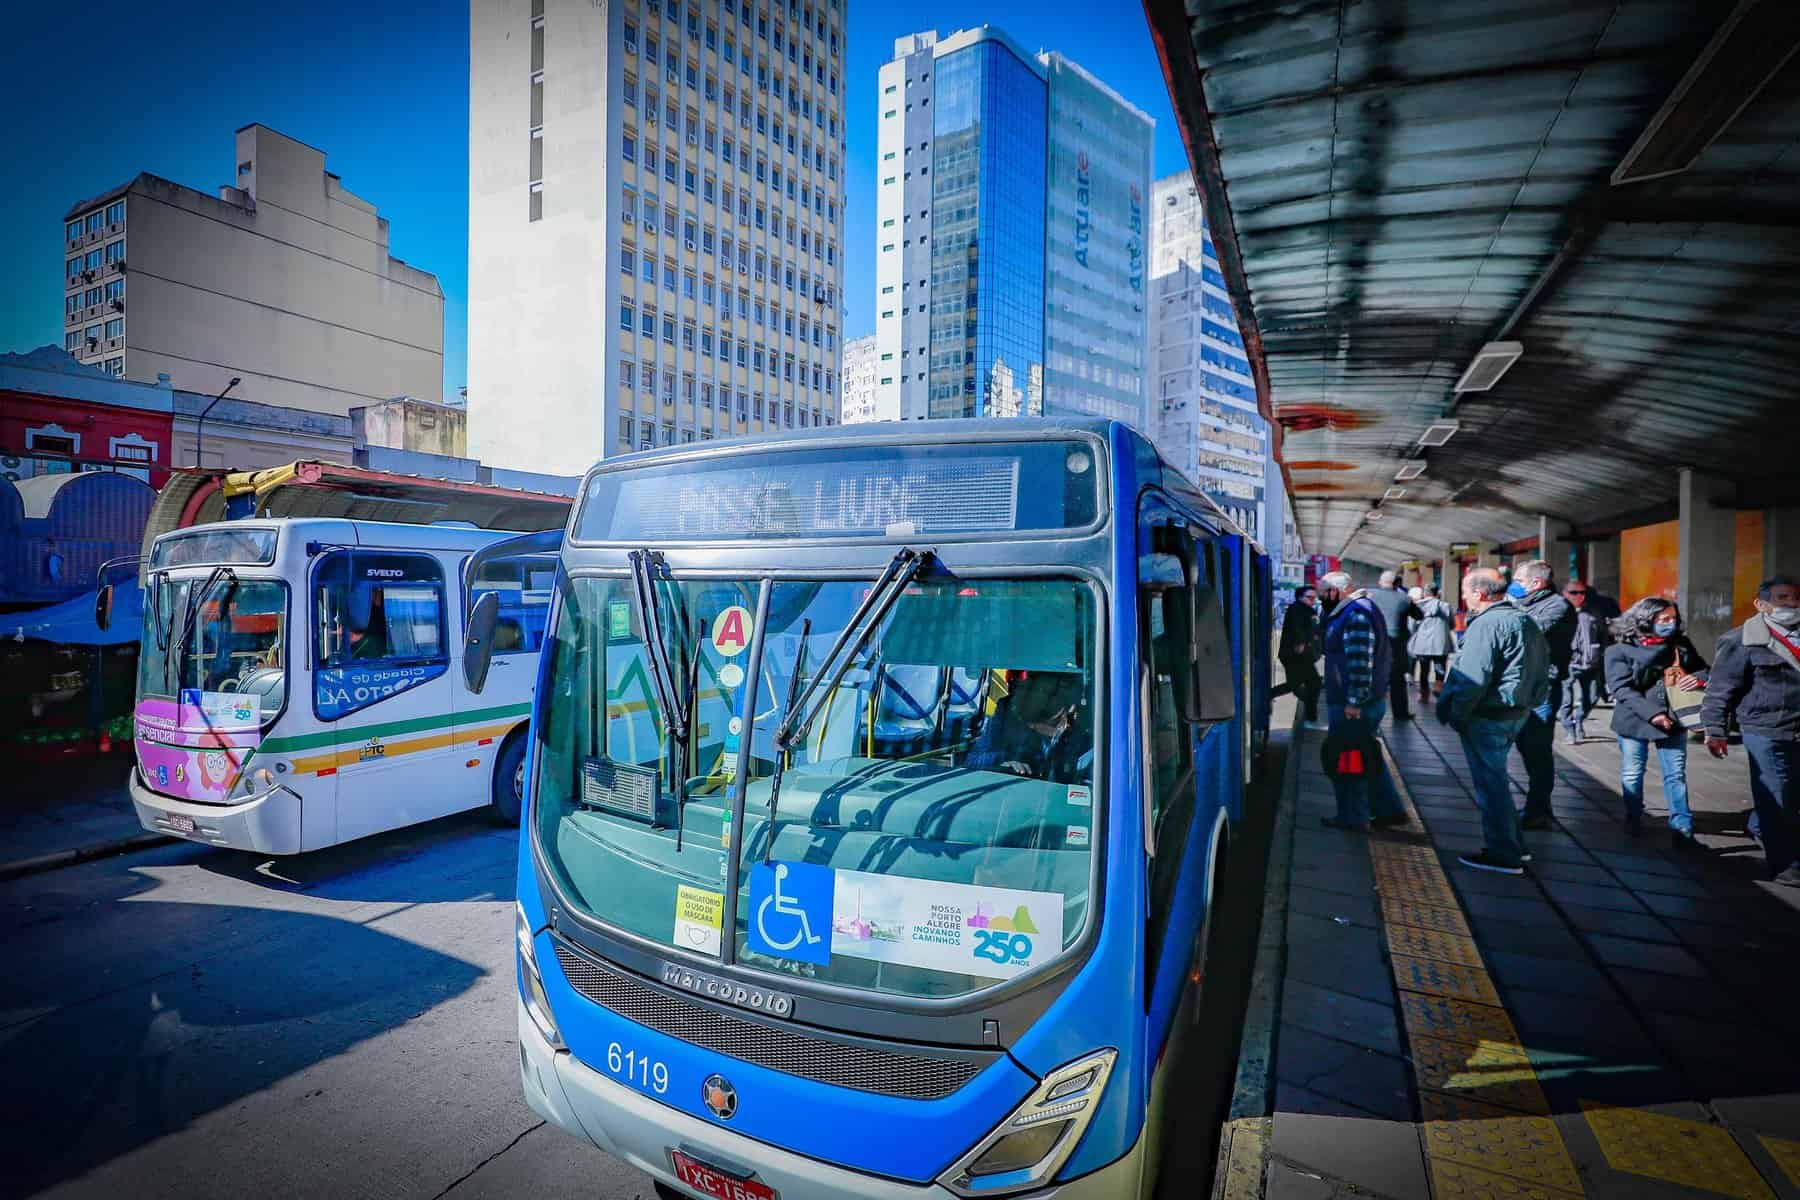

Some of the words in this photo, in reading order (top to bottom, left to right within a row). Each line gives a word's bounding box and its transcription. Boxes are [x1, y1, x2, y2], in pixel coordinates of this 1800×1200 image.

[815, 475, 928, 530] LIVRE
[366, 568, 404, 578] SVELTO
[716, 609, 746, 647] A
[931, 904, 961, 914] NOSSA
[931, 912, 961, 923] PORTO
[913, 925, 961, 938] INOVANDO
[926, 920, 961, 931] ALEGRE
[912, 934, 961, 946] CAMINHOS
[973, 929, 1033, 965] 250
[1010, 959, 1030, 967] ANOS
[607, 1041, 669, 1094] 6119
